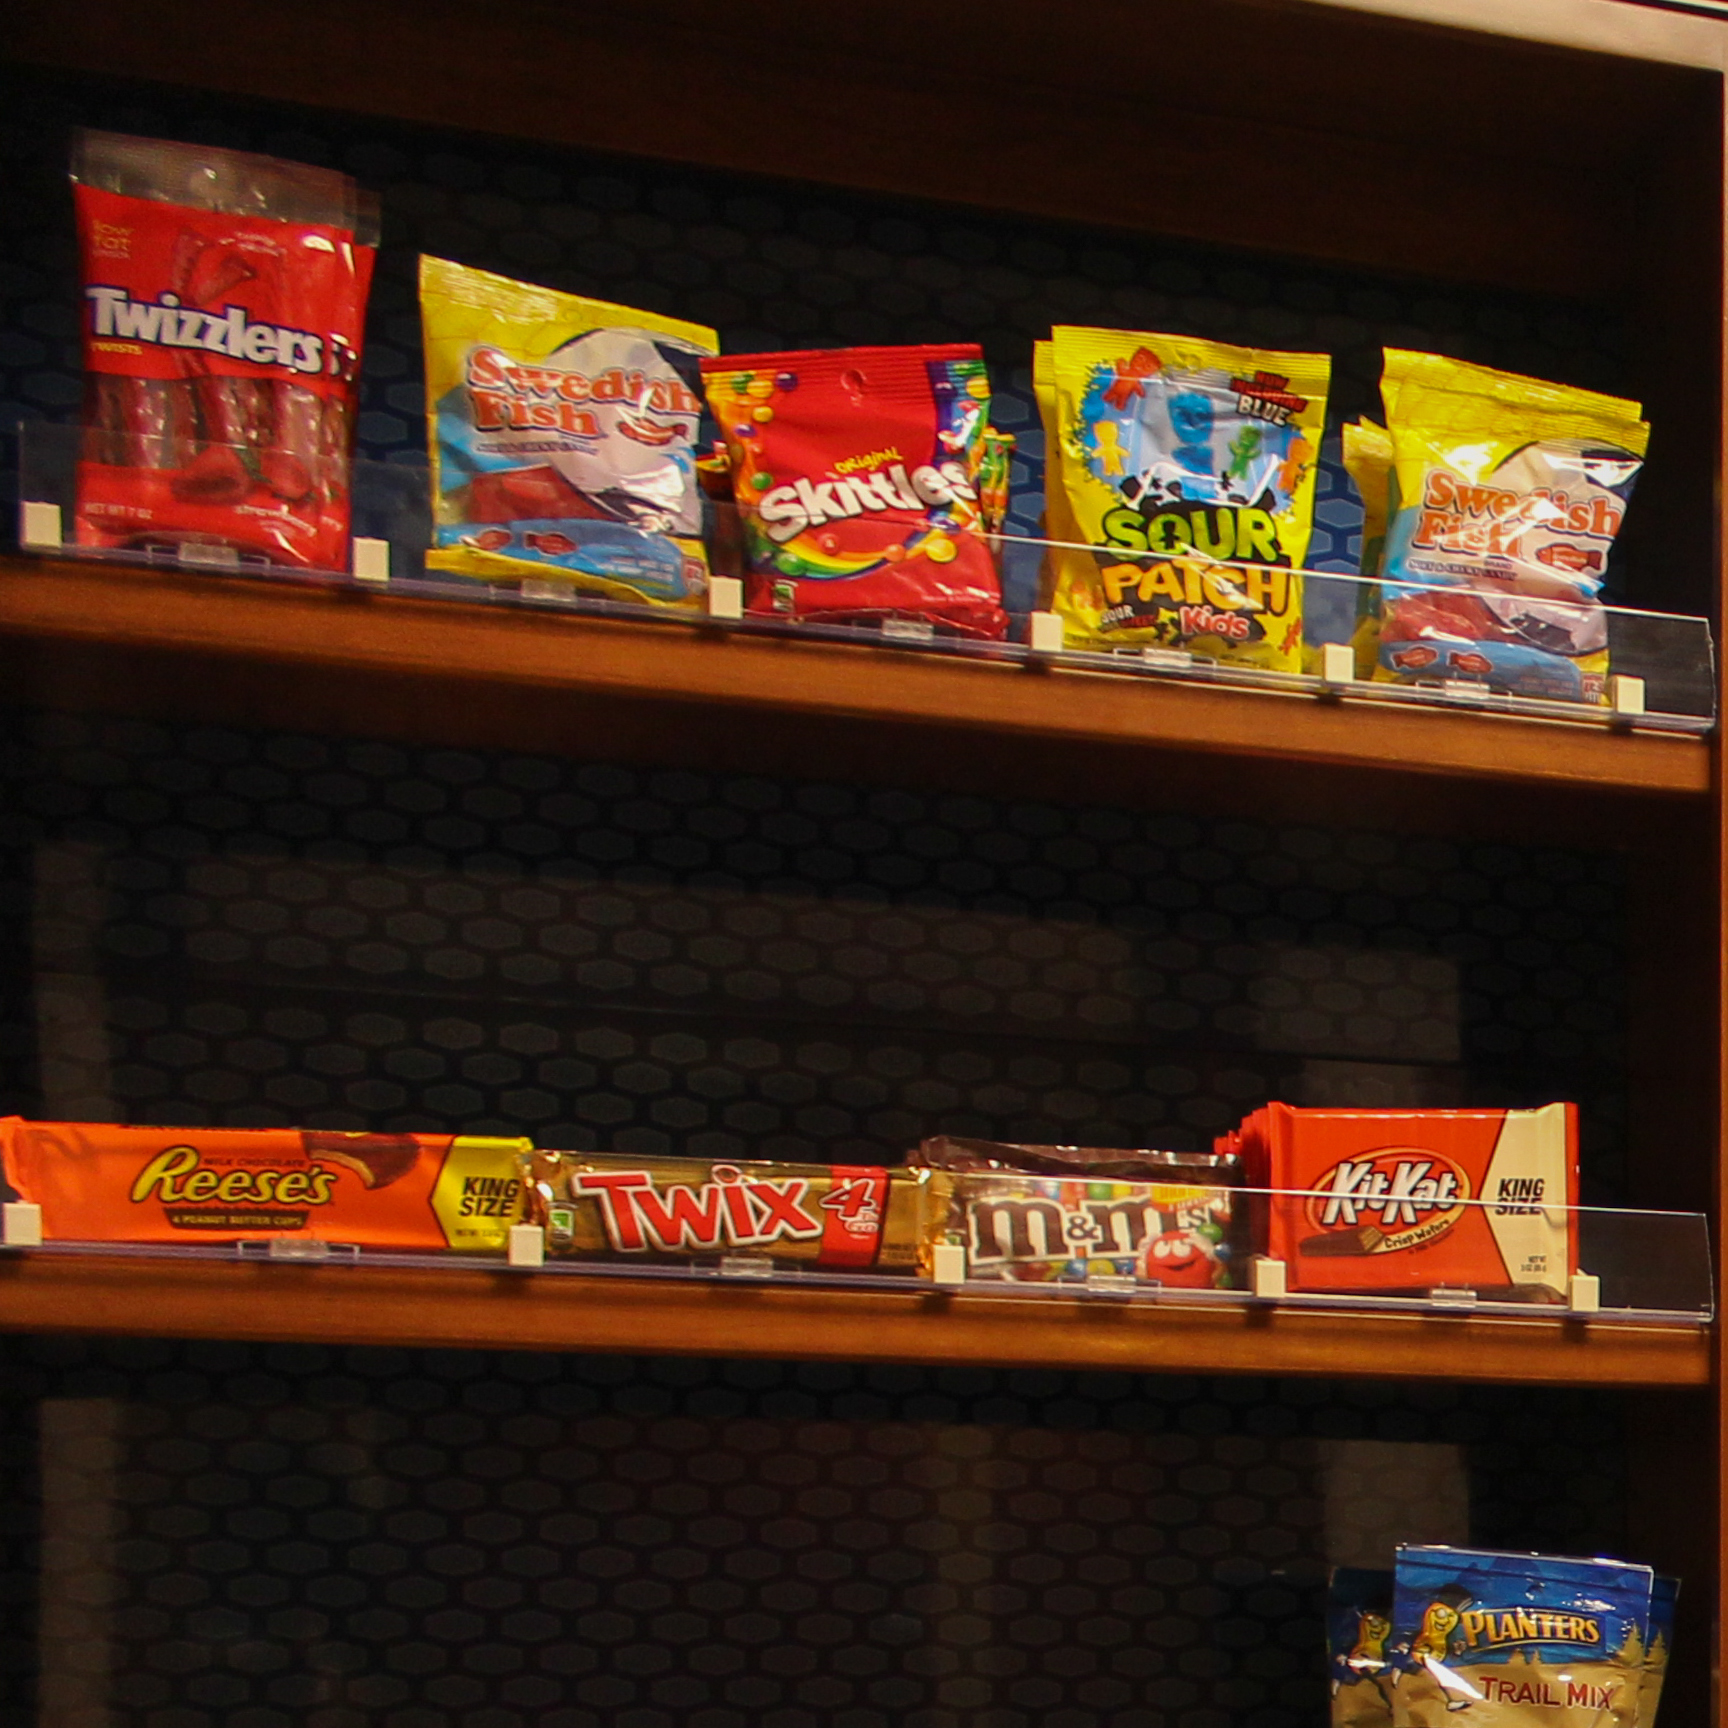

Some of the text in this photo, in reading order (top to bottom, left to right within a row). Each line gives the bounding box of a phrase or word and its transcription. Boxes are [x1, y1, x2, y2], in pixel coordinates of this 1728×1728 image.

[84, 285, 323, 374] Twizzlers
[469, 344, 701, 417] Swedish
[470, 390, 606, 438] Fish
[1237, 394, 1292, 427] BLUE
[759, 461, 977, 542] Skittles
[1424, 468, 1624, 540] Swedish
[1103, 507, 1281, 562] SOUR
[1411, 508, 1524, 562] Fish
[1101, 558, 1291, 615] PATCH
[1180, 606, 1250, 639] Kids
[132, 1145, 338, 1206] Reese's
[461, 1175, 520, 1200] KING
[1498, 1177, 1546, 1198] KING
[181, 1213, 304, 1227] PEANUT BUTTER CUPS
[458, 1198, 514, 1218] SIZE
[1494, 1197, 1543, 1217] SIZE
[1383, 1231, 1415, 1251] Crisp
[1414, 1217, 1451, 1242] Wafers
[1461, 1609, 1601, 1647] PLANTERS
[1478, 1676, 1616, 1711] TRAIL MIX
